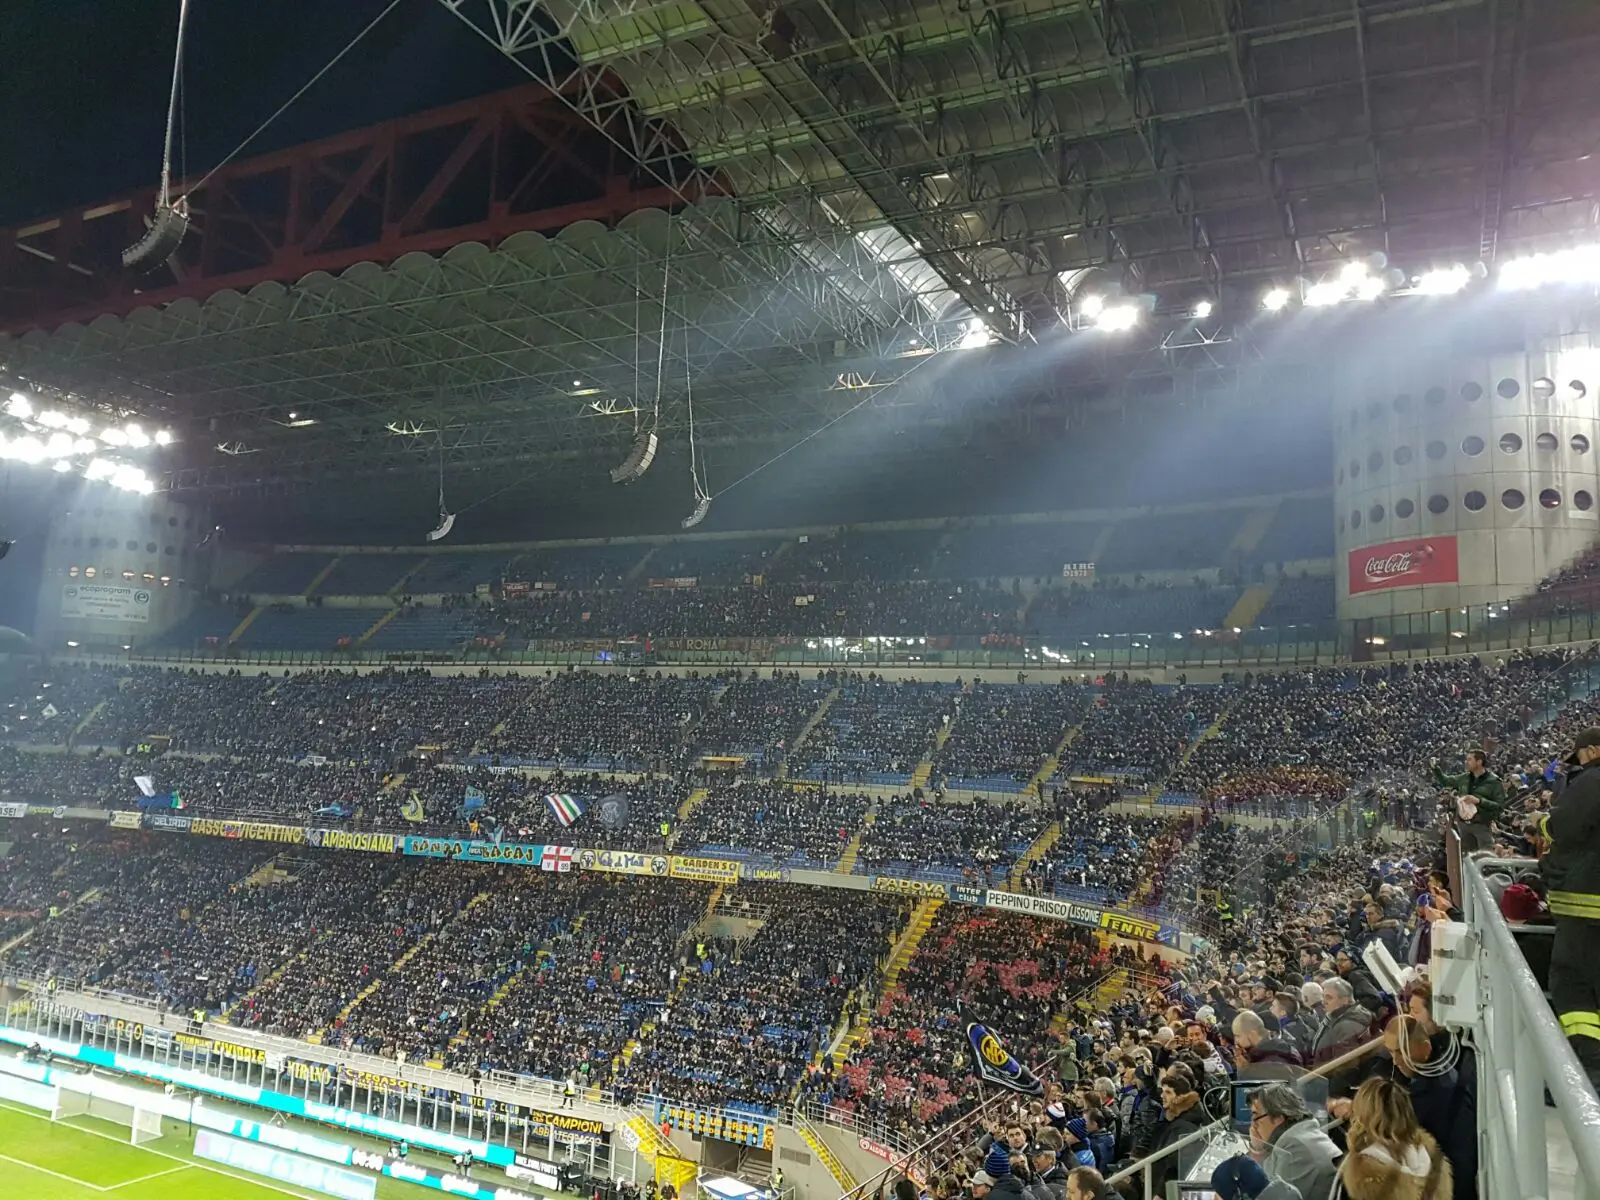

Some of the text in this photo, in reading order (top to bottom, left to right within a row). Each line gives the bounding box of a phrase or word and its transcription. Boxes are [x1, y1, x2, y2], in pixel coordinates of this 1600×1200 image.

[321, 830, 395, 852] AMBROSIANA
[957, 886, 981, 896] INTER
[959, 894, 978, 904] club
[989, 893, 1067, 917] PEPPINO PRISCO
[545, 1113, 602, 1134] CAMPIONI
